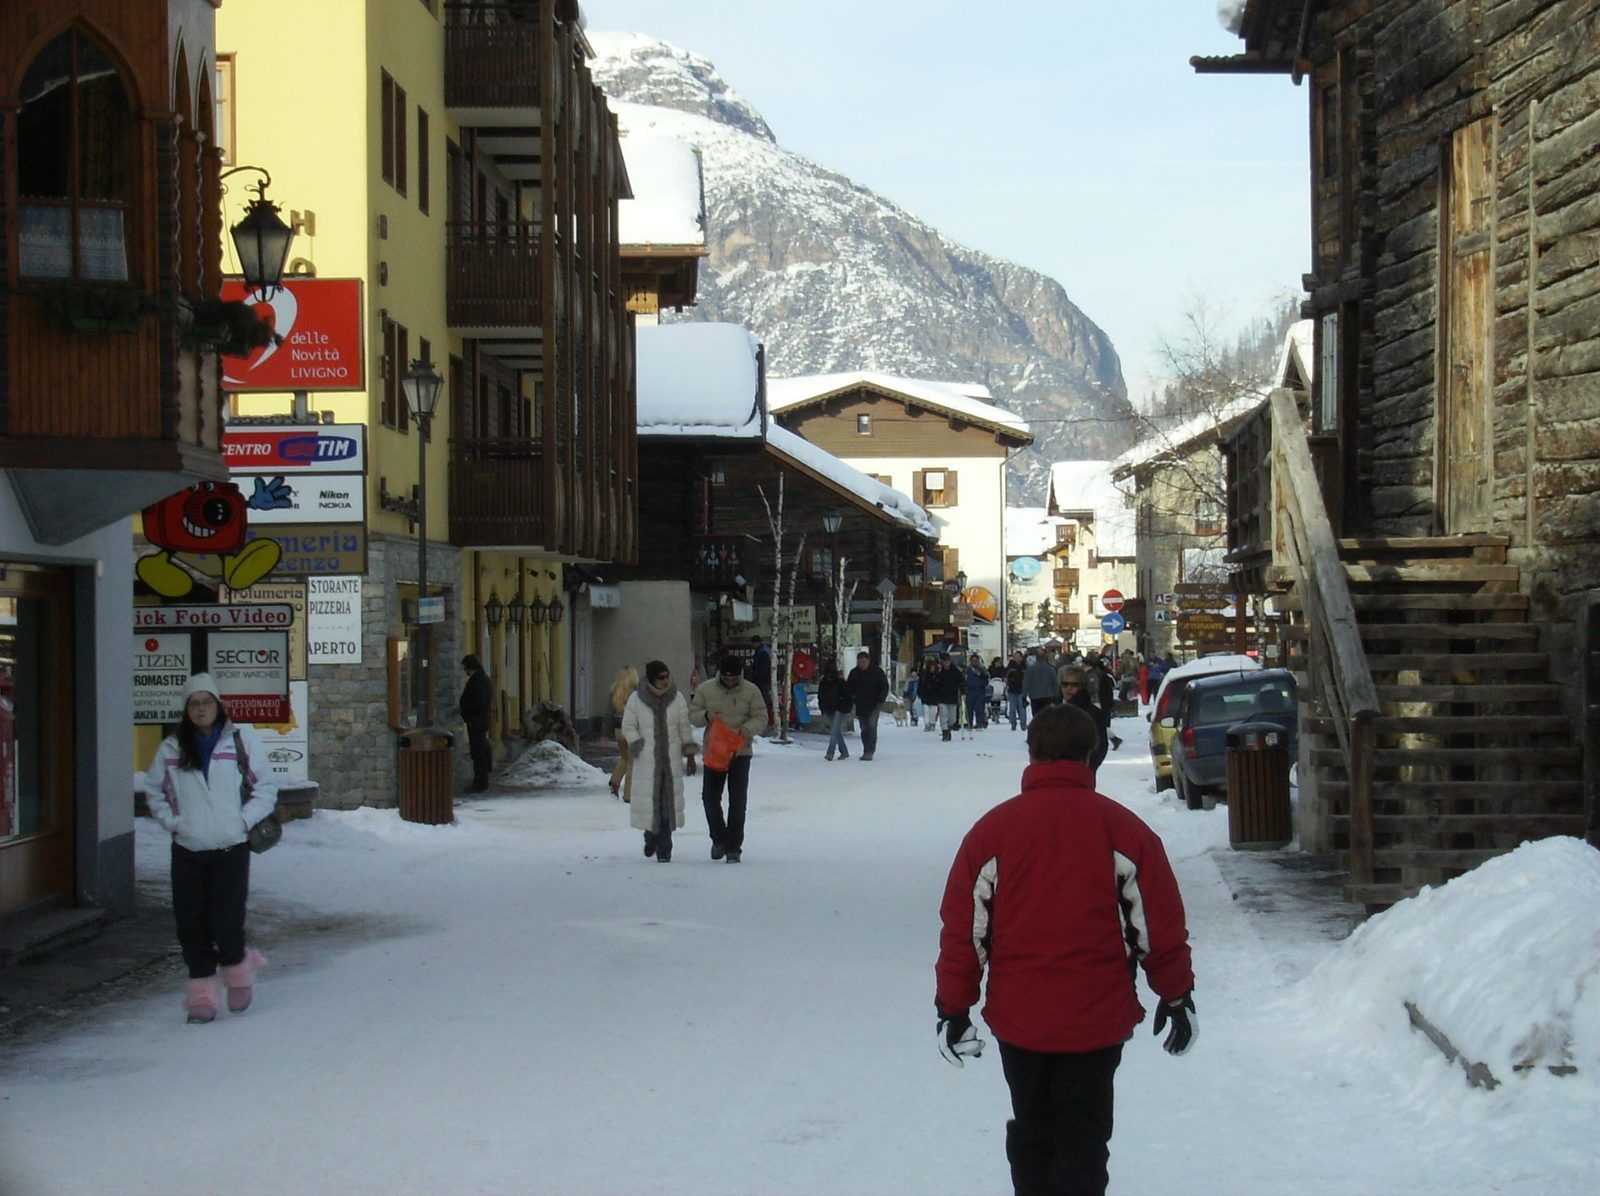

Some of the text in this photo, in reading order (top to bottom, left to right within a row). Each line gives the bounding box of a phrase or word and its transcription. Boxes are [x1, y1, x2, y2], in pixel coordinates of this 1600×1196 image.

[290, 330, 329, 344] delle
[291, 347, 340, 361] Novità
[290, 367, 348, 379] LIVIGNO
[318, 440, 350, 456] TIM
[319, 490, 350, 499] Nikon
[318, 502, 352, 510] NOKIA
[309, 600, 351, 615] PIZZERIA
[175, 609, 221, 625] Foto
[229, 608, 288, 624] Video
[216, 650, 279, 664] SECTOR
[215, 671, 280, 679] SPORT WATCHES
[160, 710, 166, 720] 3
